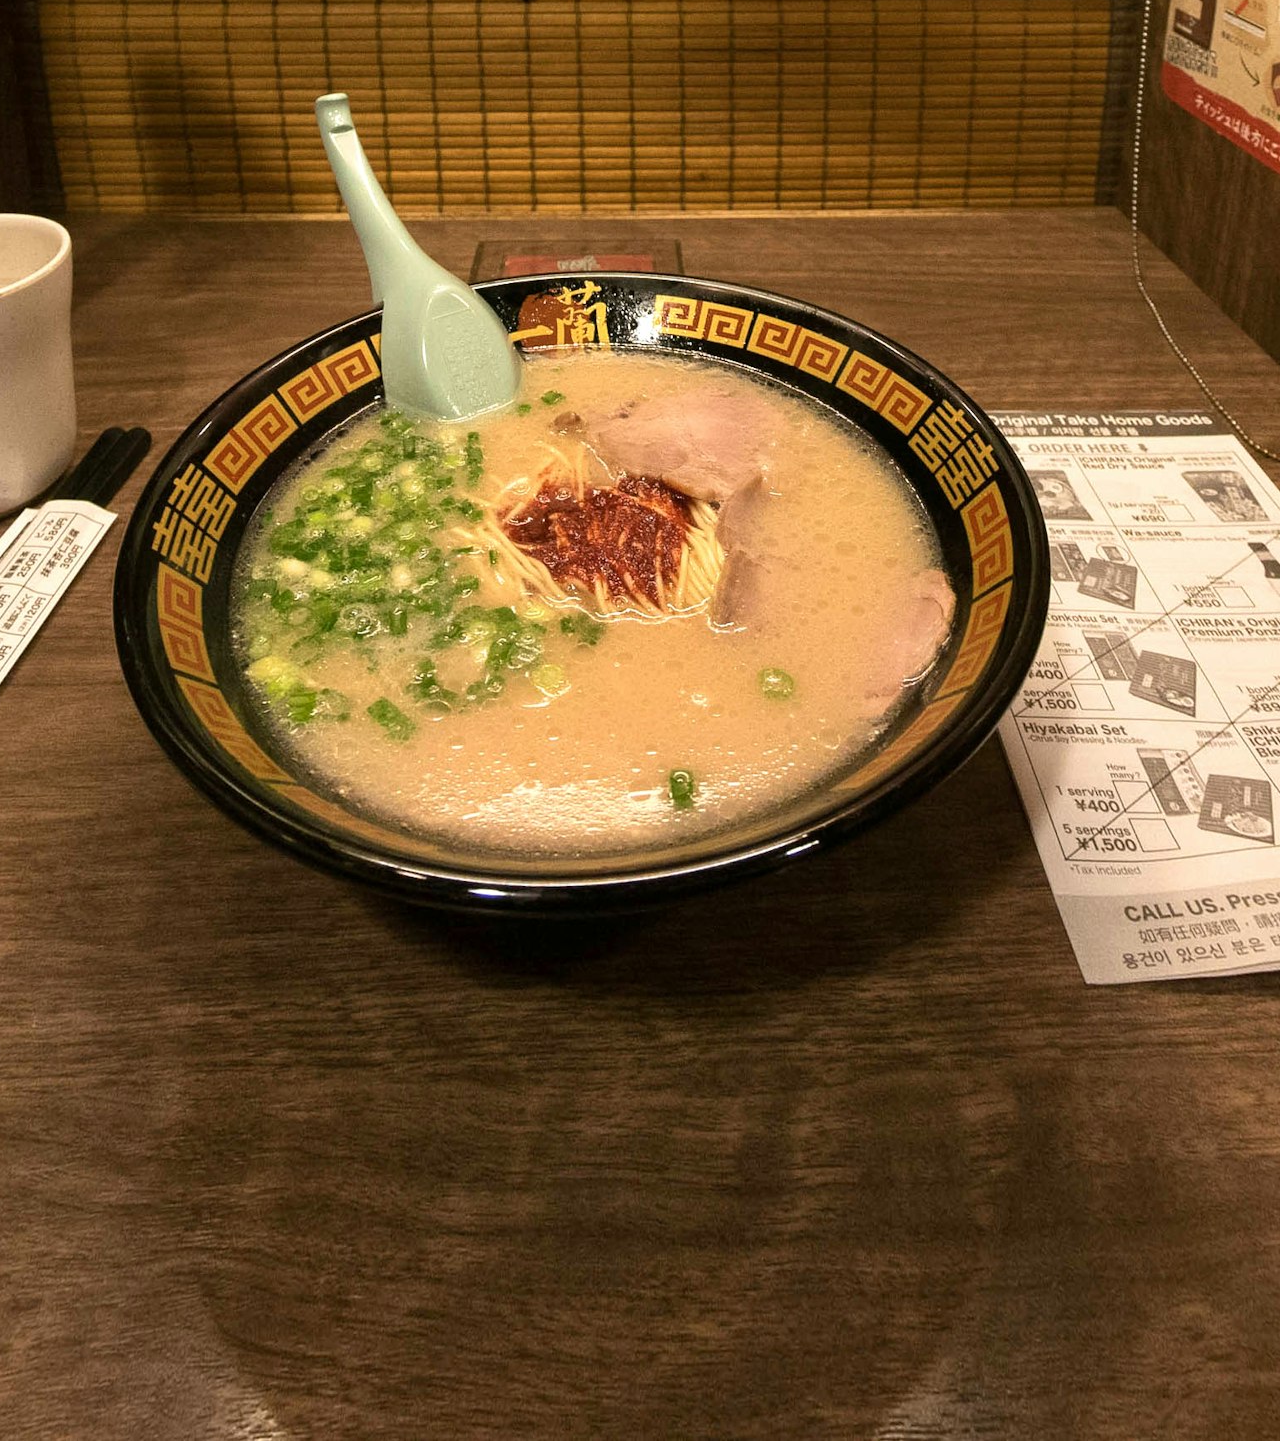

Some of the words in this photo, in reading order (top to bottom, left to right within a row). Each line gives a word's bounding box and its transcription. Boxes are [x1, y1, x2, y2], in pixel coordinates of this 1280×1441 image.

[1054, 414, 1099, 426] Take
[1101, 415, 1154, 427] Home
[1155, 414, 1214, 426] Goods
[1028, 443, 1086, 454] ORDER
[1089, 443, 1133, 454] HERE
[1122, 528, 1183, 538] Wa-sauce
[59, 543, 84, 571] 390円
[16, 552, 43, 579] 250円
[1099, 614, 1121, 624] Set
[1175, 617, 1246, 628] ICHIRAN's
[1181, 626, 1244, 638] Premium
[1022, 722, 1099, 736] Hiyakabai
[1100, 724, 1128, 736] Set
[1067, 787, 1115, 799] serving
[1074, 798, 1121, 813] ¥400
[1062, 822, 1073, 835] 5
[1076, 825, 1131, 838] servings
[1075, 837, 1138, 853] ¥1,500
[1097, 865, 1143, 876] Included
[1123, 904, 1184, 923] CALL
[1183, 897, 1226, 916] US.
[1122, 949, 1172, 970] 용건이
[1176, 942, 1227, 964] 있으신
[1230, 937, 1267, 957] 분은
